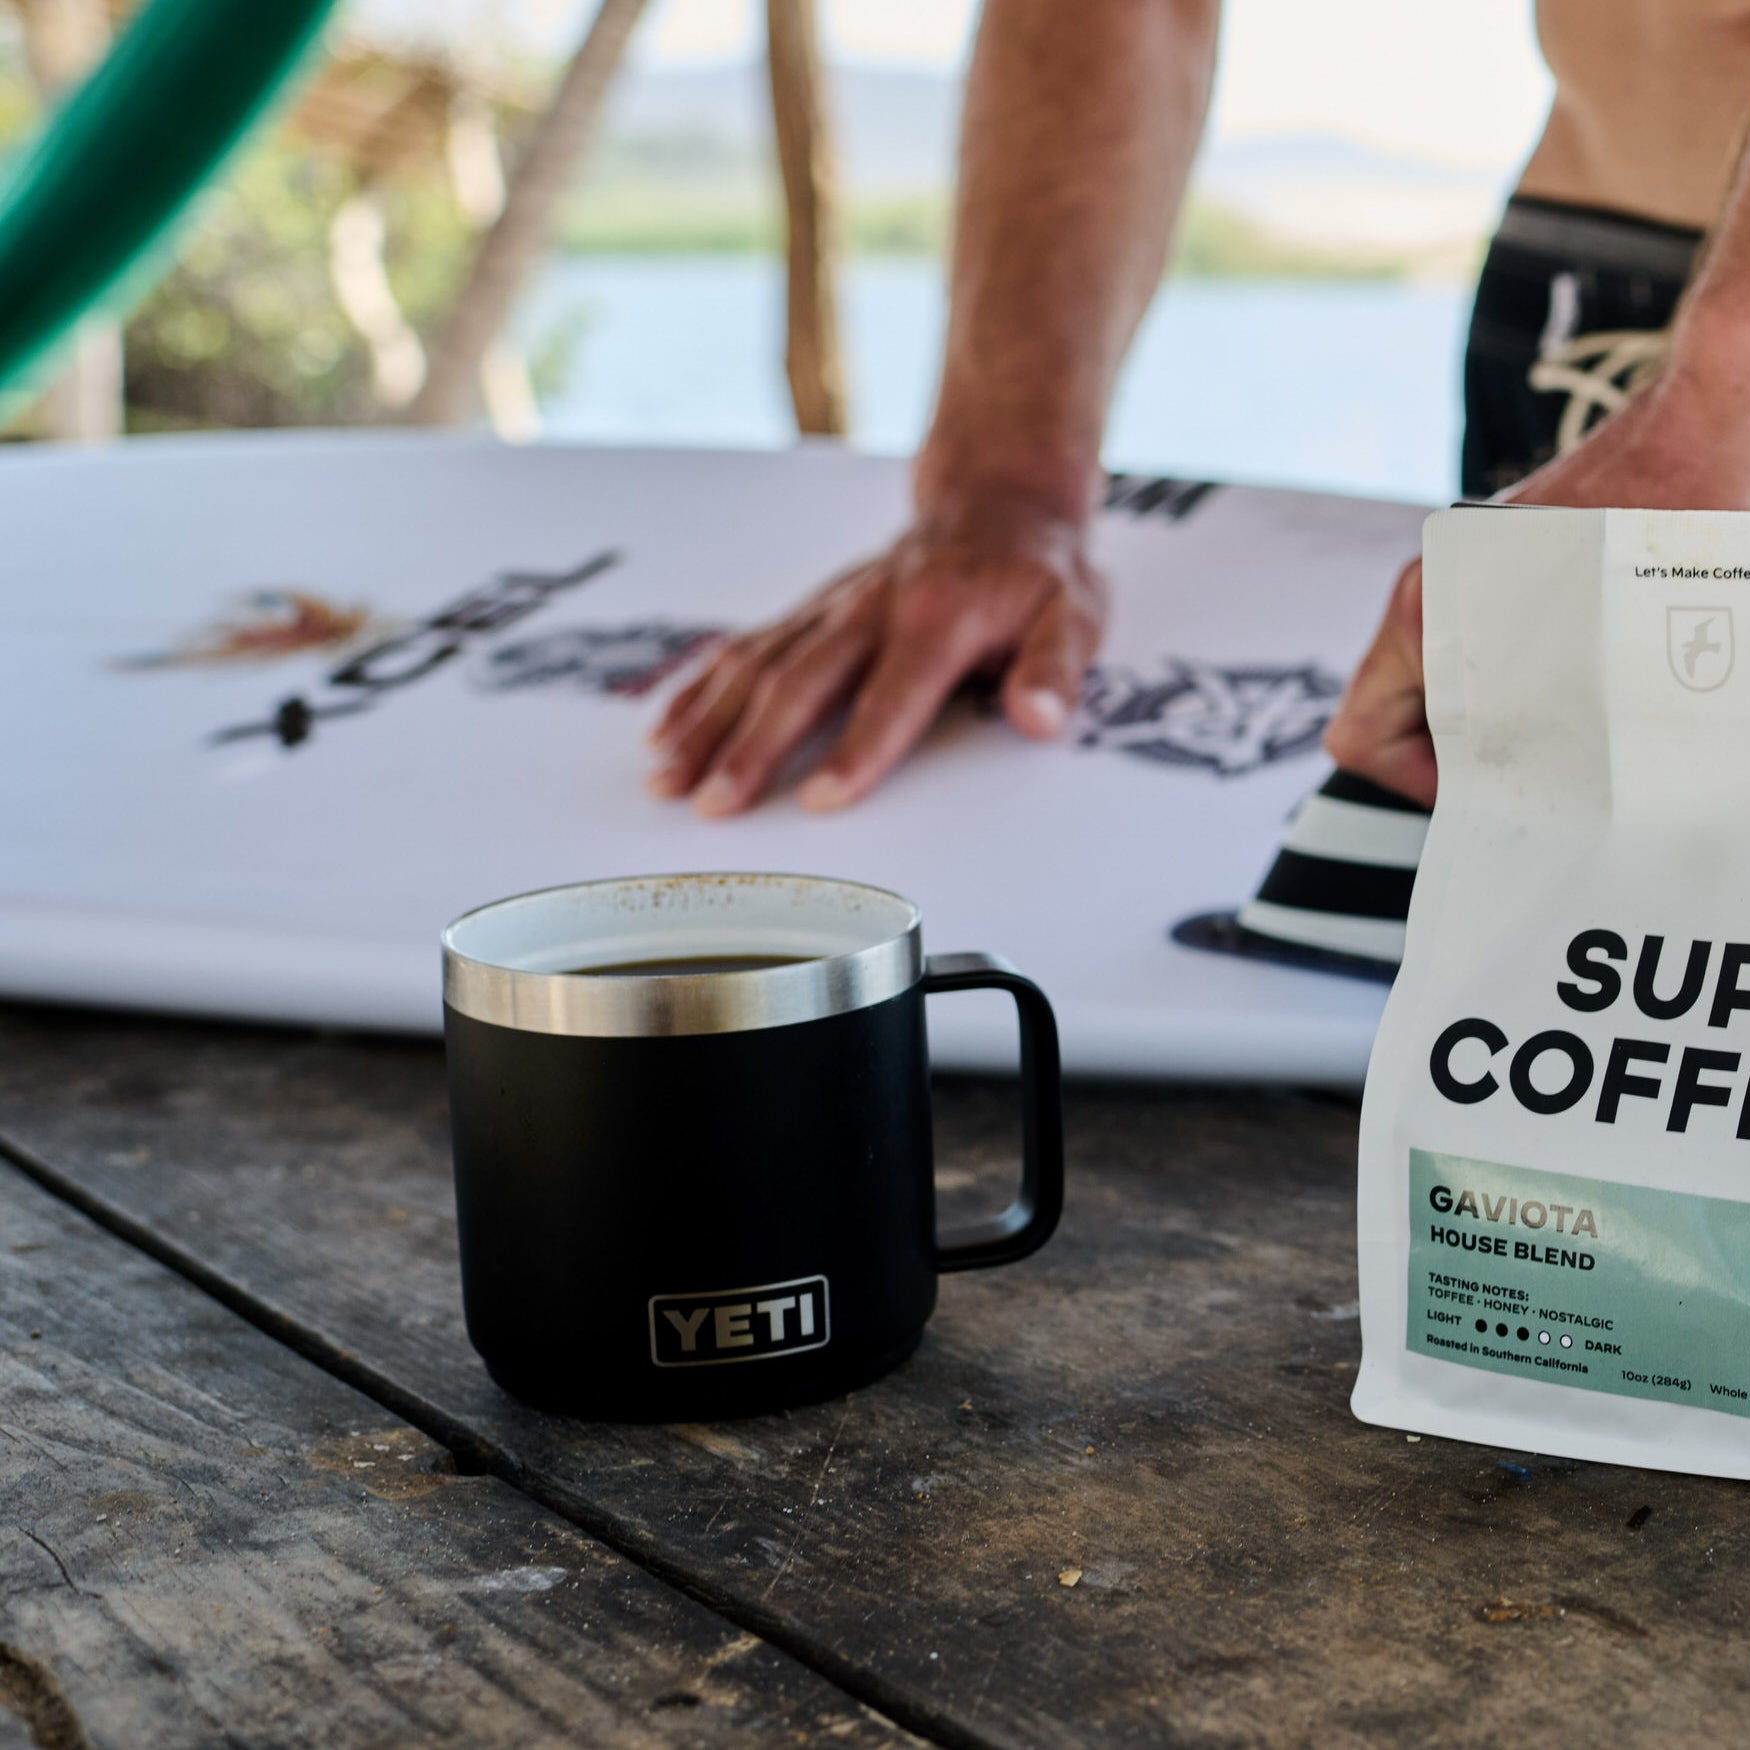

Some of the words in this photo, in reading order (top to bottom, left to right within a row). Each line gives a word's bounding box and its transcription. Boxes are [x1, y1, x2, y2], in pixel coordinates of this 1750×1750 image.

[1635, 566, 1668, 578] Let's
[1672, 567, 1709, 578] Make
[1429, 1185, 1598, 1239] GAVIOTA
[1430, 1225, 1507, 1256] HOUSE
[1514, 1241, 1595, 1271] BLEND
[1428, 1272, 1479, 1292] TASTING
[1482, 1283, 1529, 1301] NOTES:
[663, 1293, 814, 1352] YETI
[1428, 1287, 1474, 1305] TOFFEE
[1484, 1299, 1529, 1315] HONEY
[1539, 1308, 1614, 1331] NOSTALGIC
[1427, 1310, 1462, 1326] LIGHT
[1585, 1340, 1622, 1355] DARK
[1427, 1334, 1467, 1351] Roasted
[1470, 1342, 1479, 1354] in
[1482, 1347, 1531, 1364] Southern
[1534, 1356, 1589, 1373] California
[1621, 1370, 1649, 1383] 10oz
[1651, 1374, 1692, 1391] (284g)
[1709, 1384, 1748, 1400] Whole
